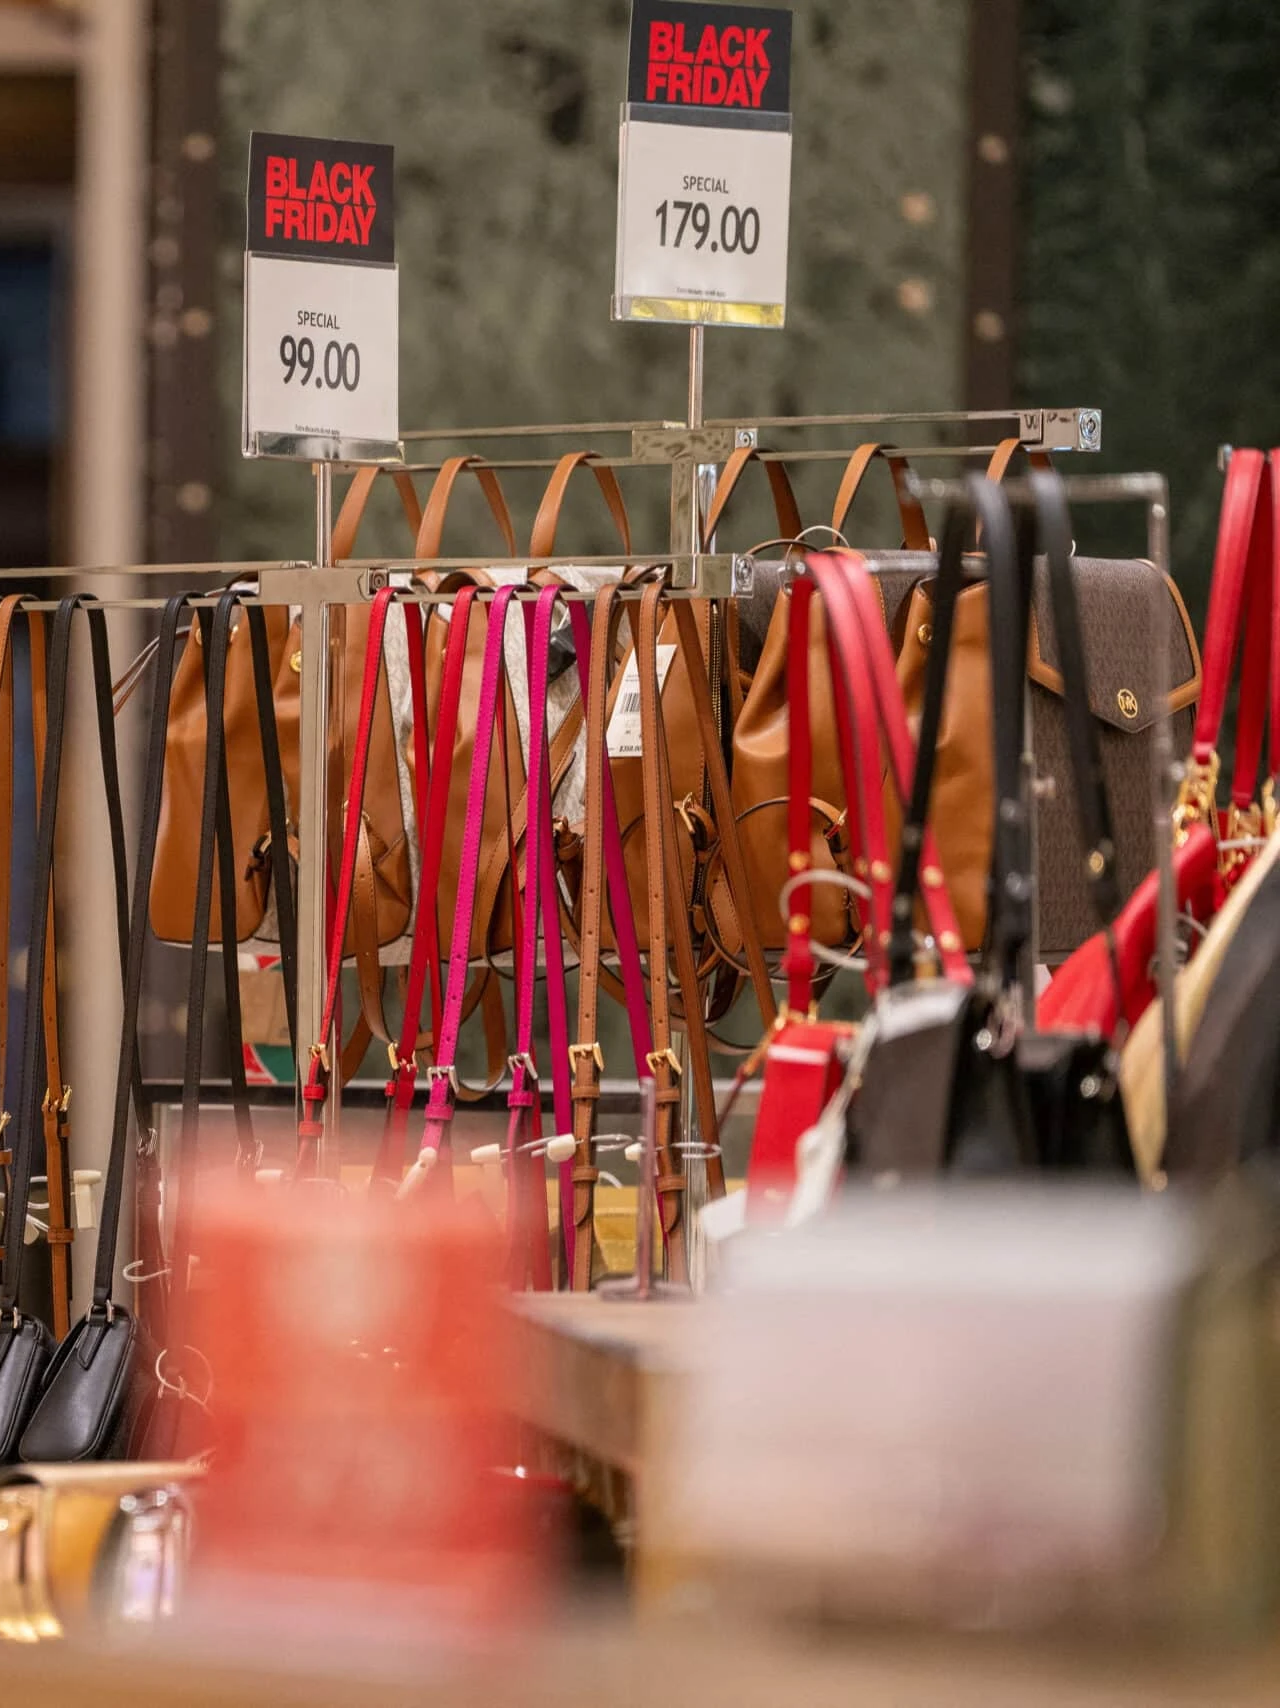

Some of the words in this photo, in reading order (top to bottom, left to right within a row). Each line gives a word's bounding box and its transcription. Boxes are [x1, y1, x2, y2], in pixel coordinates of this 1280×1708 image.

[648, 21, 771, 68] BLACK
[646, 62, 770, 107] FRIDAY
[266, 156, 376, 206] BLACK
[683, 176, 729, 194] SPECIAL
[265, 198, 376, 246] FRIDAY
[655, 199, 761, 255] 179.00
[297, 310, 340, 330] SPECIAL
[280, 335, 360, 392] 99.00
